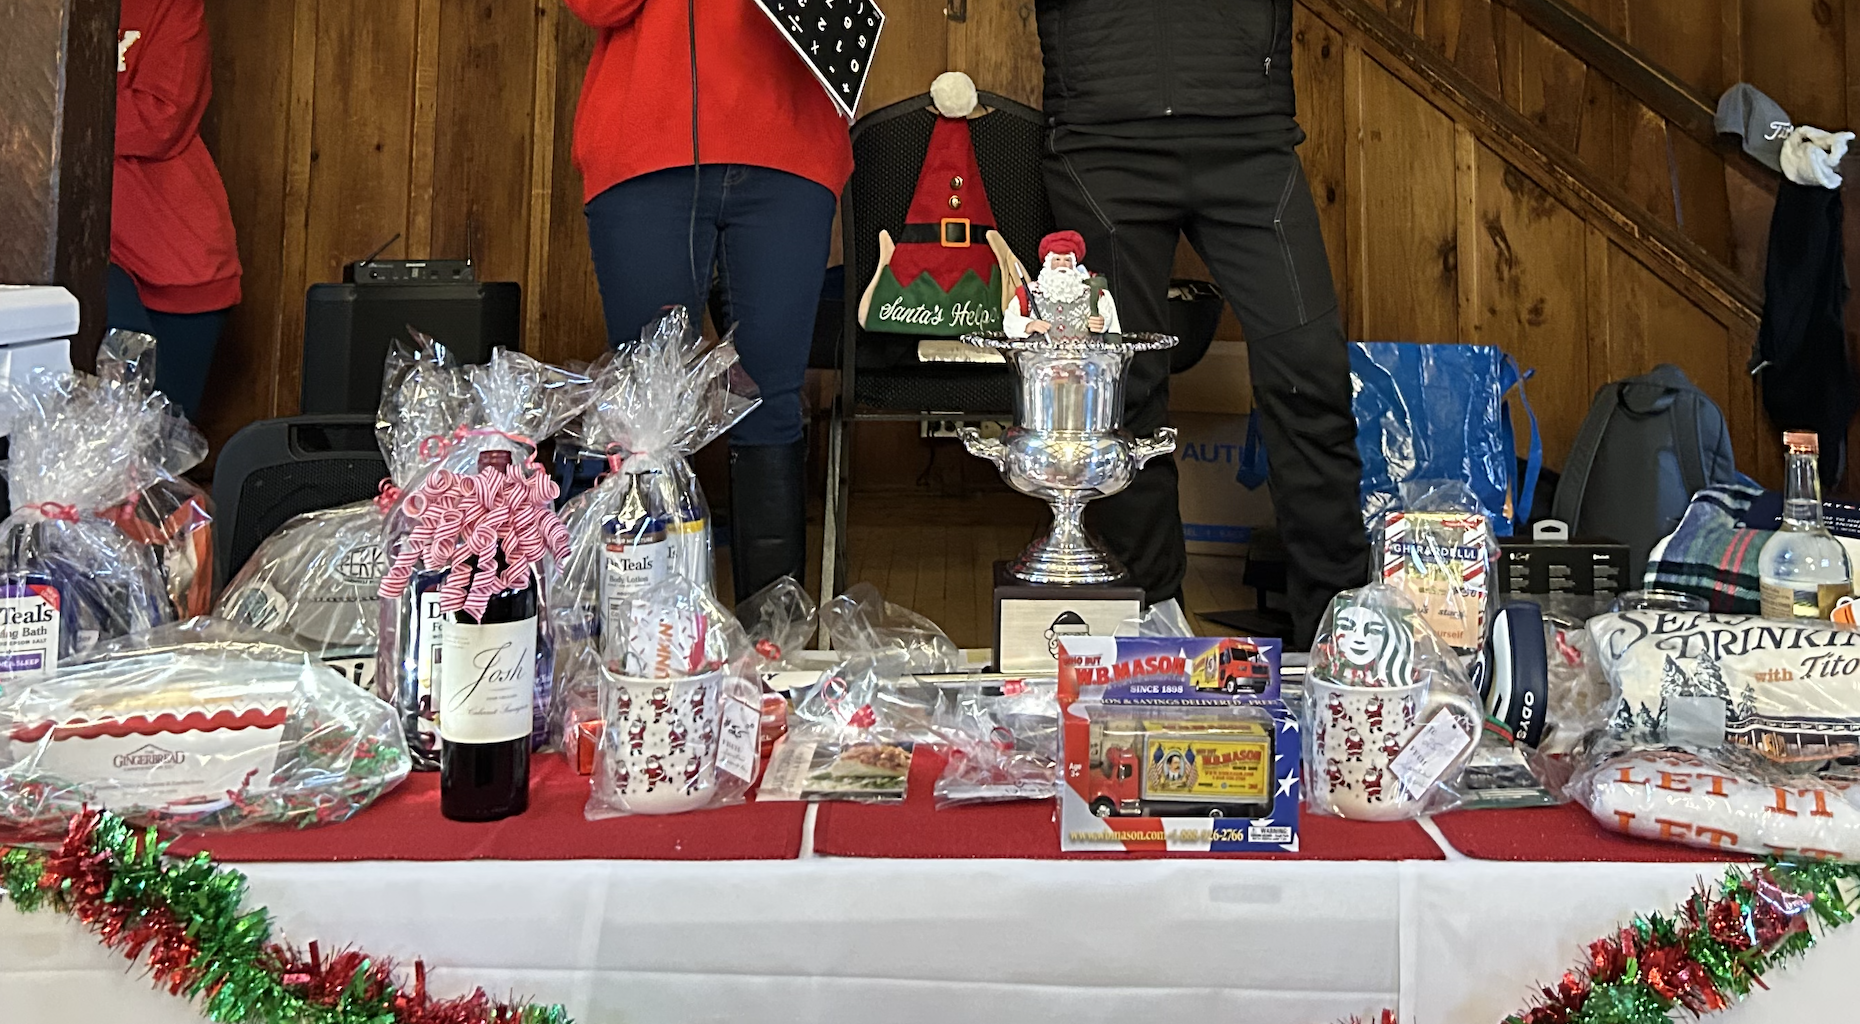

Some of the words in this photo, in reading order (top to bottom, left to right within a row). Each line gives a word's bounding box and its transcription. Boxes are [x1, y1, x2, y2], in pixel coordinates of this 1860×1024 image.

[879, 296, 945, 325] Santa's
[949, 301, 1000, 330] Help
[620, 556, 653, 570] Teal's
[609, 576, 624, 584] Body
[0, 602, 54, 625] Teal's
[0, 628, 19, 640] ing
[22, 626, 47, 637] Bath
[16, 658, 40, 666] SLEEP
[1085, 656, 1101, 666] BUT
[447, 641, 527, 713] Josh
[1754, 668, 1793, 683] with
[1130, 685, 1159, 694] SINCE
[1161, 685, 1184, 694] 1898
[1133, 698, 1180, 706] SAVINGS
[113, 751, 186, 769] GINGERBREAD
[1068, 762, 1082, 772] Age
[1070, 770, 1080, 778] 3+
[1612, 766, 1739, 798] LET
[1763, 785, 1835, 819] IT
